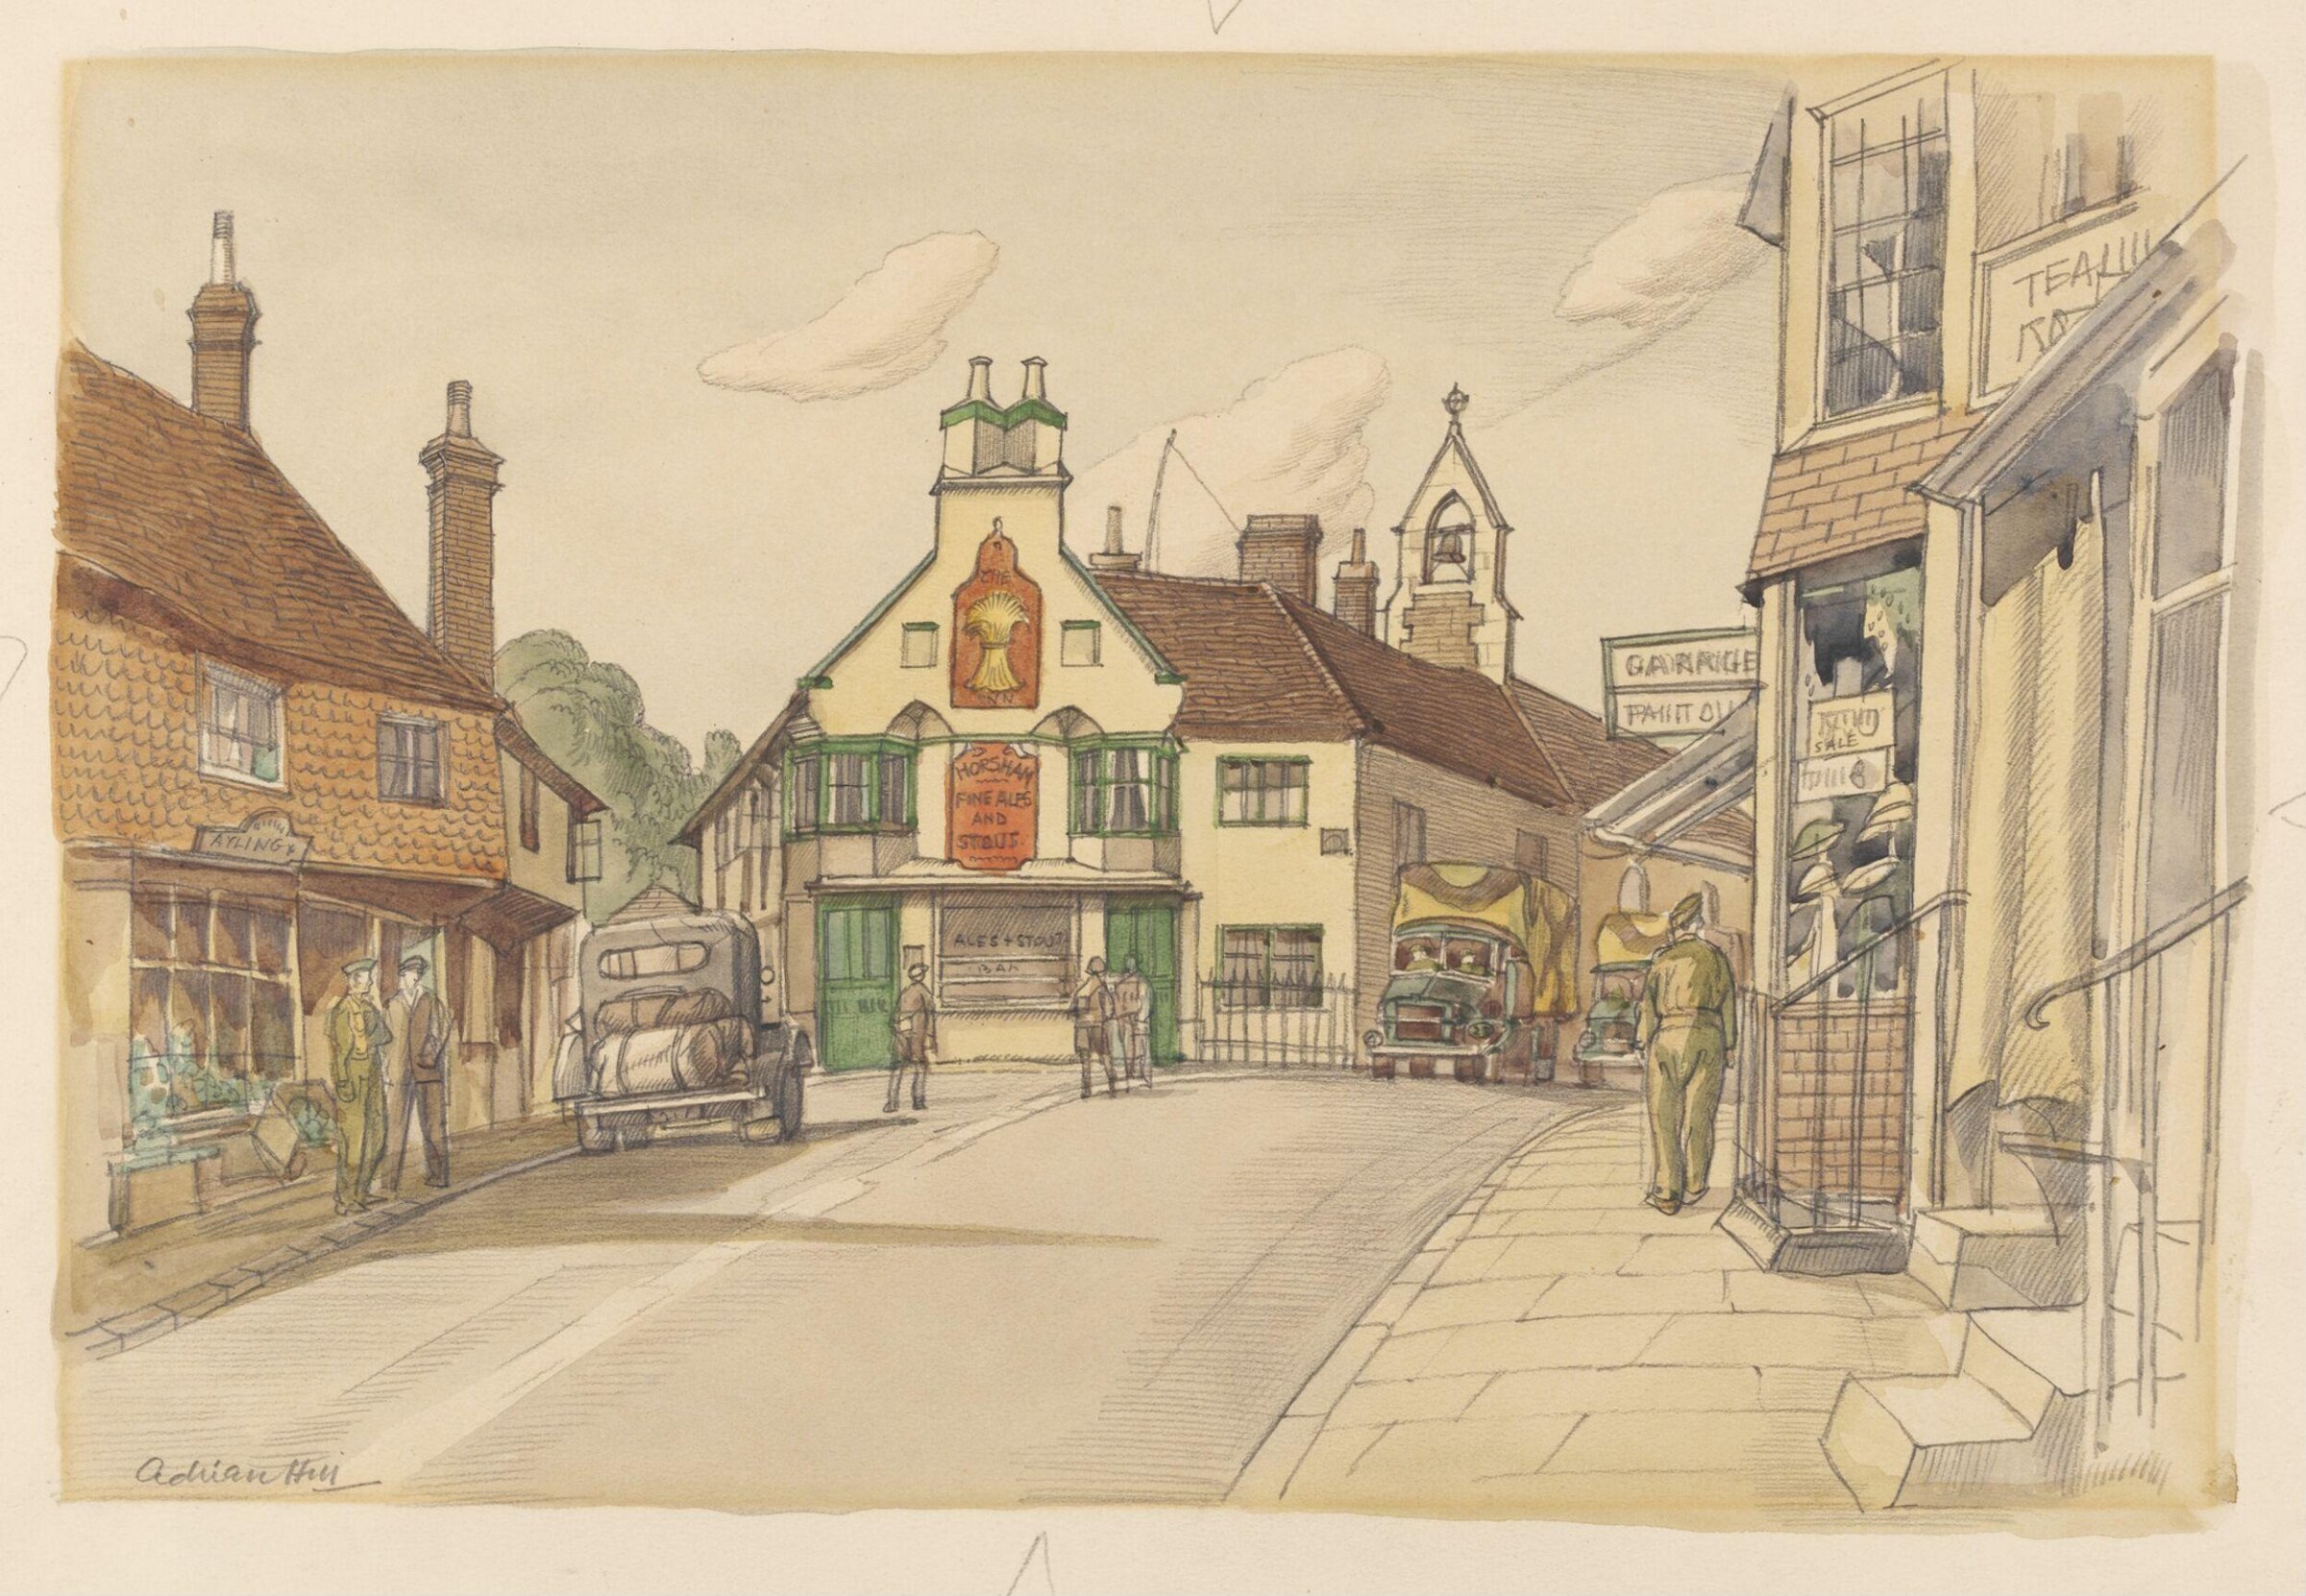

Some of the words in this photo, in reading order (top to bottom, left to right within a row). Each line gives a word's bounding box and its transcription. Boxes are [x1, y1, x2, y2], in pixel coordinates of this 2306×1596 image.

[955, 790, 994, 809] FINE
[995, 790, 1032, 809] ALES
[970, 811, 1007, 826] AND
[957, 830, 1020, 850] STOUT
[953, 933, 999, 948] ALES
[1016, 931, 1063, 948] STOUT
[135, 1456, 276, 1487] Adrian
